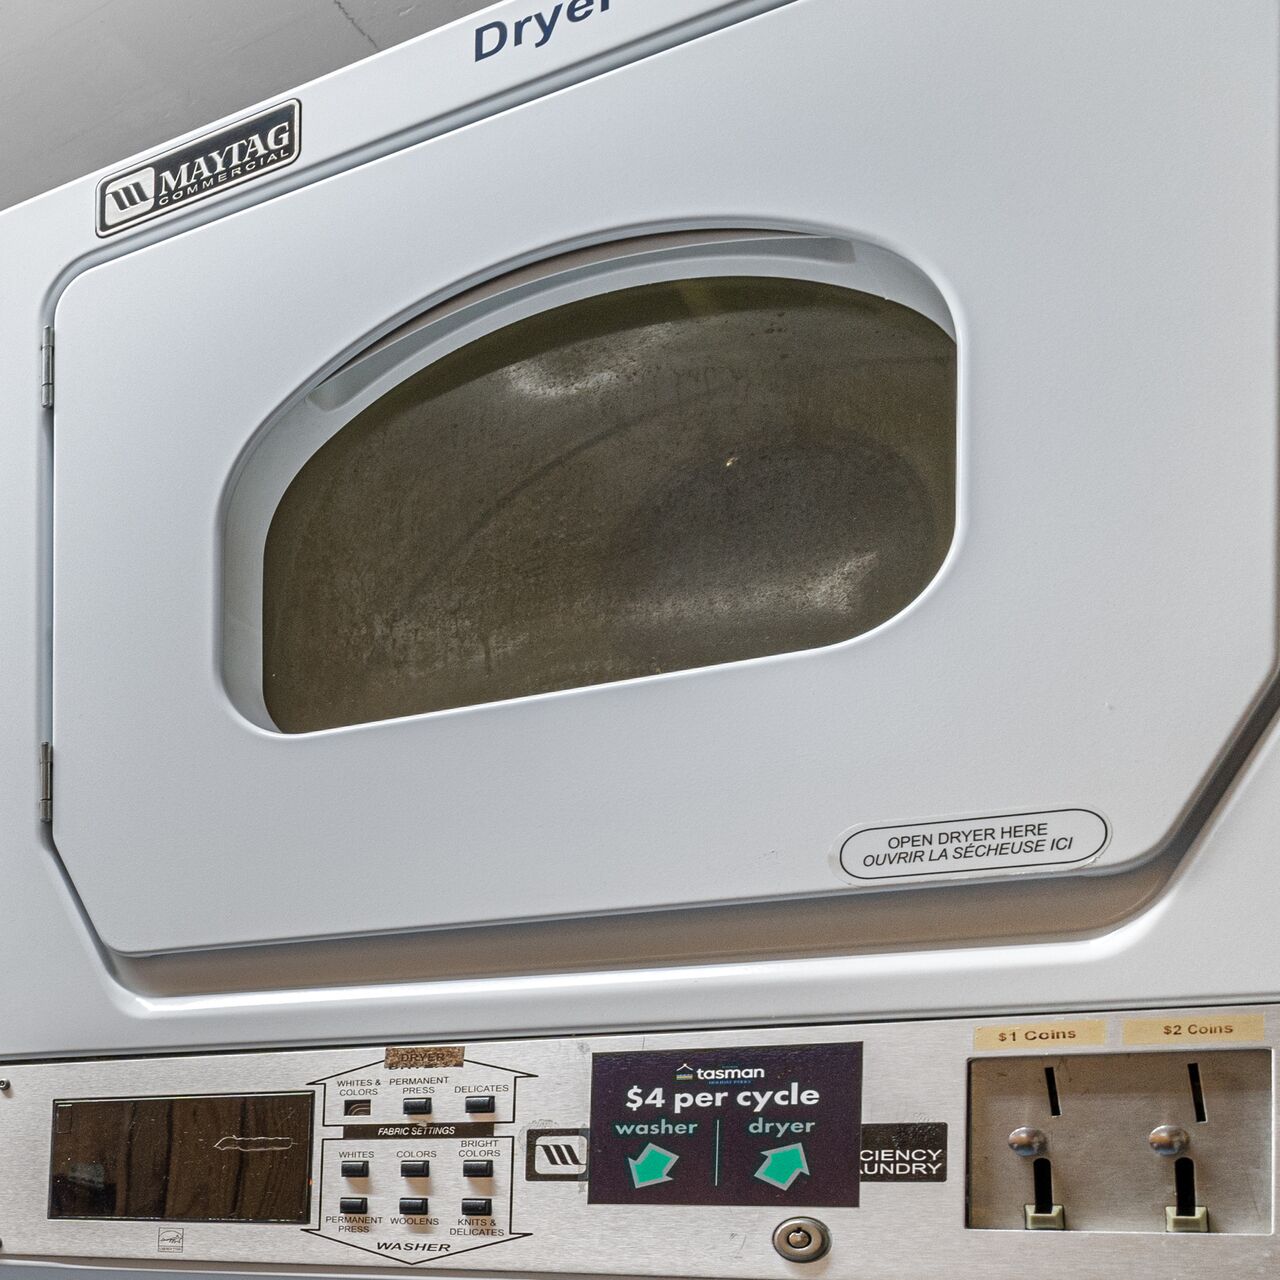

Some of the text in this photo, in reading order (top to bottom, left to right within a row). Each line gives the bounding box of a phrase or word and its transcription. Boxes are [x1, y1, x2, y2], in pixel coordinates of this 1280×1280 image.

[158, 121, 290, 197] MAYTAG
[159, 149, 289, 206] COMMERCIAL
[888, 823, 1048, 849] OPEN DRYER HERE
[863, 837, 1073, 867] OUVRIR LA SÉCHEUSE ICI
[1163, 1023, 1233, 1036] $2 Coins
[998, 1029, 1076, 1042] $1 Coins
[400, 1053, 446, 1062] DRYER
[696, 1066, 765, 1080] tasman
[337, 1080, 372, 1088] WHITES
[389, 1077, 449, 1086] PERMANENT
[339, 1088, 378, 1096] COLORS
[403, 1086, 435, 1094] PRESS
[454, 1085, 509, 1094] DELICATES
[625, 1082, 820, 1114] $4 per cycle
[378, 1126, 456, 1136] FABRIC SETTINGS
[615, 1118, 698, 1135] washer
[748, 1117, 815, 1138] dryer
[461, 1140, 499, 1148] BRIGHT
[338, 1151, 375, 1159] WHITES
[396, 1150, 437, 1158] COLORS
[458, 1149, 501, 1158] COLORS
[860, 1163, 942, 1175] UNDRY
[326, 1216, 383, 1224] PERMANENT
[390, 1217, 440, 1226] WOOLENS
[458, 1218, 497, 1227] KNITS &
[338, 1225, 370, 1233] PRESS
[449, 1228, 505, 1237] DELICATES
[377, 1242, 451, 1252] WASHER
